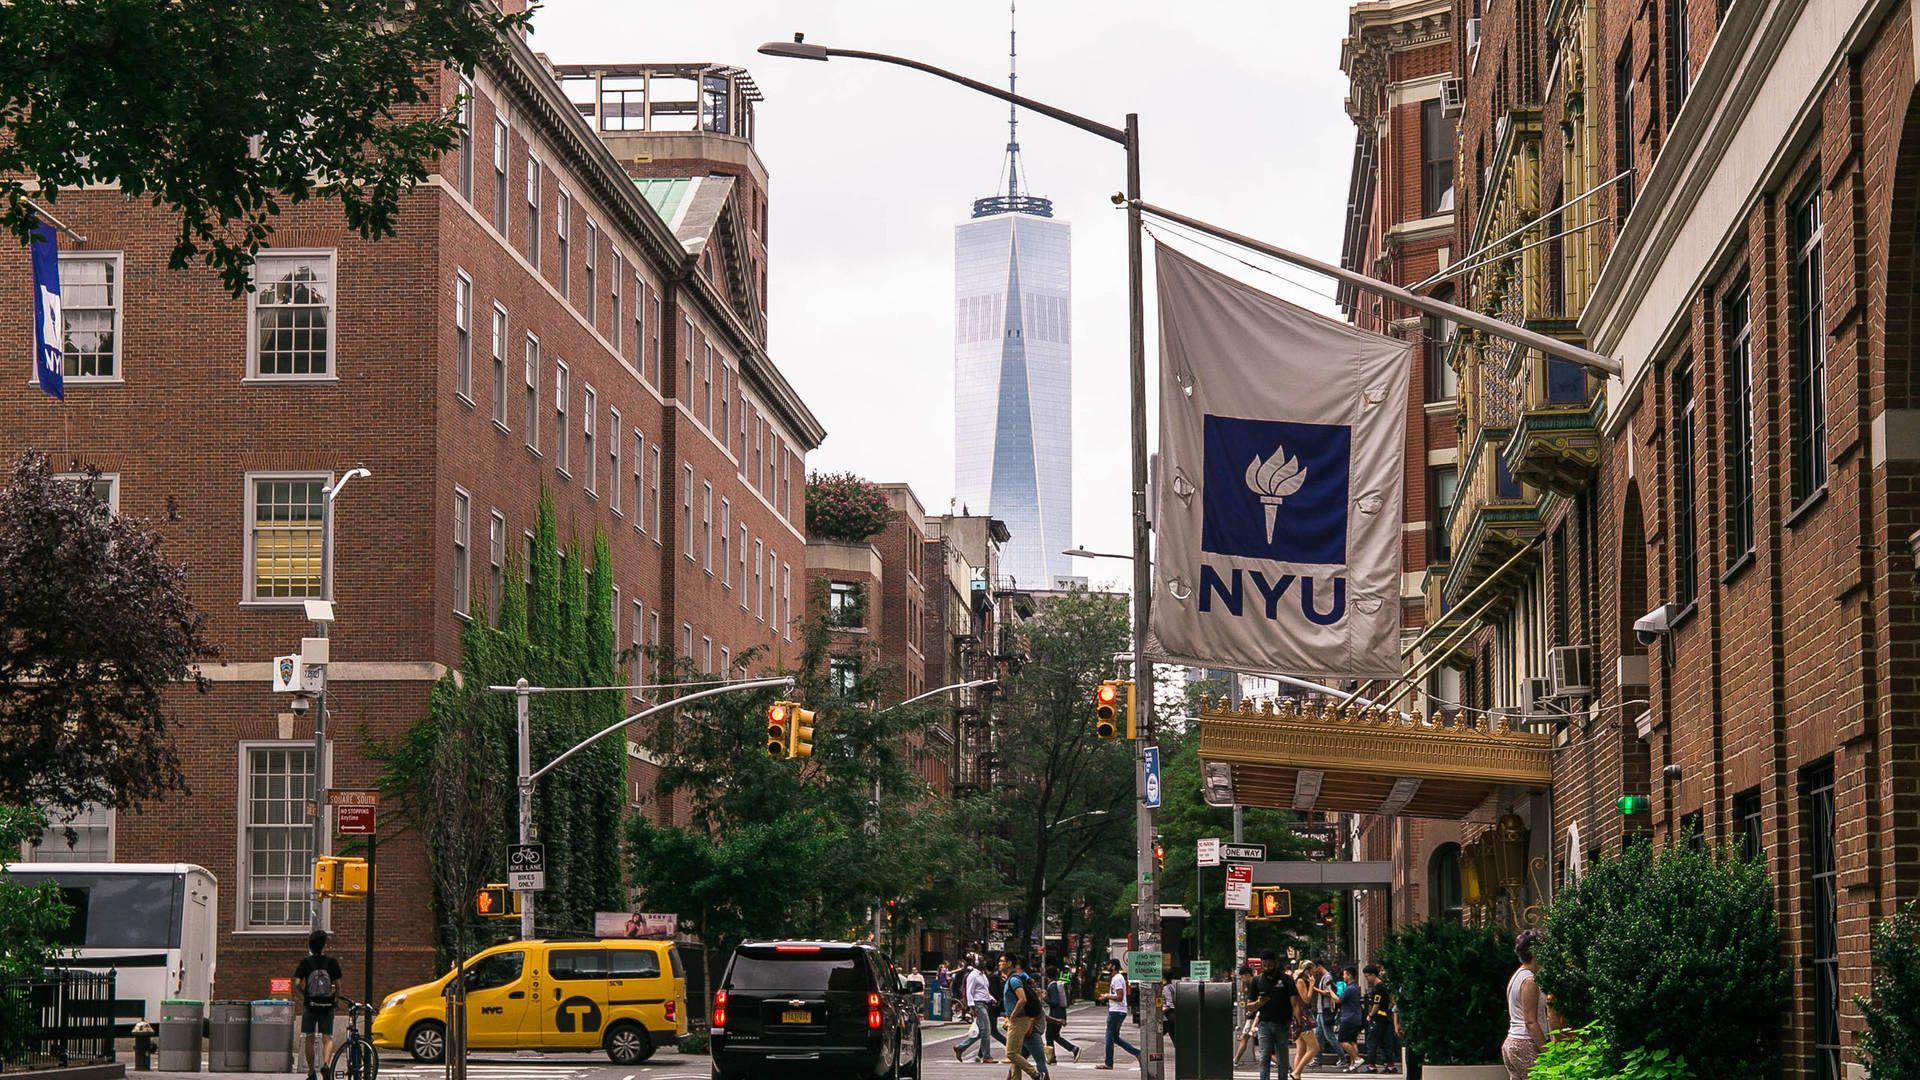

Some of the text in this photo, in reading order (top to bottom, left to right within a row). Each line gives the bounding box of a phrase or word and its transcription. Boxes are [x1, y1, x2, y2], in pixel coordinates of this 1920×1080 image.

[1199, 564, 1346, 626] NYU
[330, 795, 376, 804] SQUARE SOUTH
[1225, 848, 1260, 857] ONE WAY
[481, 1006, 503, 1015] NYC
